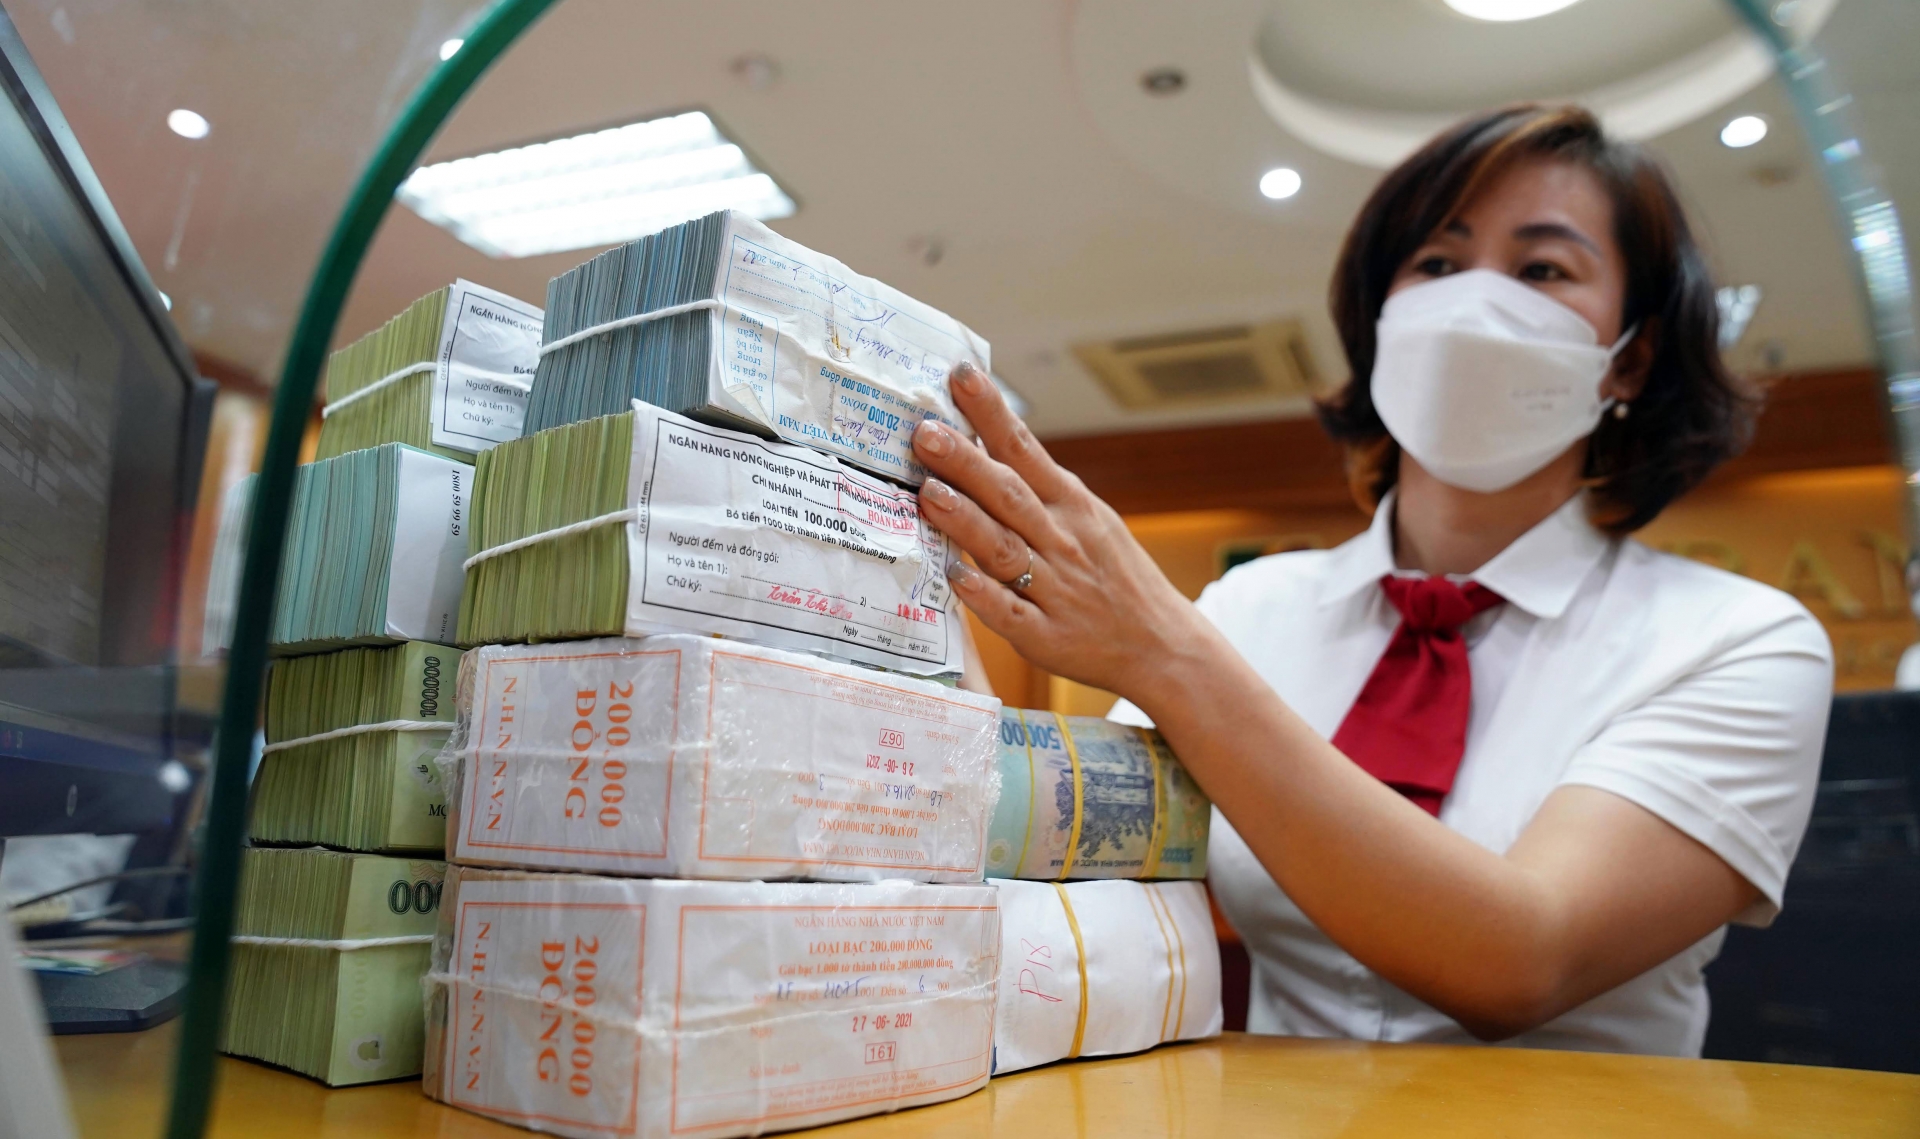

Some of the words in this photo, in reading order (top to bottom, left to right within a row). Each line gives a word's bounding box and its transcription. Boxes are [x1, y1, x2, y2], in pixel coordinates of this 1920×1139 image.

[470, 305, 494, 321] NGÂN
[494, 314, 519, 328] HÀNG
[740, 313, 764, 329] hàng
[737, 327, 762, 342] Ngân
[750, 343, 763, 353] nội
[737, 350, 761, 366] trong
[743, 367, 756, 377] giá
[820, 367, 840, 383] đồng
[466, 379, 492, 392] Người
[492, 385, 512, 398] đếm
[514, 389, 524, 398] và
[841, 377, 882, 400] 20.000.000
[464, 397, 477, 408] Họ
[478, 398, 488, 408] và
[489, 400, 503, 411] tên
[840, 395, 869, 412] ĐỒNG
[463, 412, 480, 423] Chữ
[778, 414, 801, 432] NAM
[868, 405, 900, 431] 20.000
[802, 422, 828, 440] VIỆT
[858, 442, 866, 452] &
[867, 443, 902, 467] NGHIỆP
[669, 434, 699, 450] NGÂN
[701, 442, 731, 459] HÀNG
[733, 450, 763, 466] NÔNG
[763, 460, 796, 478] NGHIỆP
[797, 470, 808, 482] VÀ
[809, 471, 831, 490] PHÁT
[452, 469, 461, 493] 1800
[642, 481, 649, 496] mm
[752, 474, 767, 488] CHI
[768, 480, 802, 499] NHÁNH
[452, 494, 462, 507] 59
[452, 507, 461, 521] 99
[762, 499, 779, 514] LOẠI
[780, 503, 799, 519] TIỀN
[804, 510, 848, 533] 100.000
[451, 523, 461, 537] 59
[726, 509, 739, 519] Bó
[763, 516, 783, 529] 1000
[797, 526, 820, 540] thành
[838, 538, 879, 557] 100.000.000
[669, 531, 700, 546] Người
[702, 538, 724, 552] đếm
[726, 543, 737, 554] và
[739, 546, 762, 561] đóng
[764, 552, 780, 564] gói:
[667, 553, 681, 567] Họ
[684, 558, 695, 568] và
[698, 560, 714, 572] tên
[717, 563, 728, 575] 1):
[666, 575, 688, 588] Chữ
[688, 580, 702, 593] ký:
[859, 597, 867, 608] 2)
[843, 624, 859, 637] Ngày
[876, 634, 892, 647] tháng
[420, 656, 441, 718] 100.000
[881, 731, 903, 747] 067
[486, 676, 518, 830] N.H.N.N.V.N
[565, 686, 601, 820] ĐỒNG
[598, 680, 634, 828] 200.000
[871, 805, 891, 816] thành
[877, 822, 896, 837] BẠC
[898, 823, 918, 838] LOẠI
[794, 914, 824, 928] NGÂN
[827, 914, 857, 928] HÀNG
[859, 914, 879, 927] NHÀ
[882, 914, 907, 928] NƯỚC
[909, 915, 925, 929] VIỆT
[926, 915, 945, 927] NAM
[809, 941, 840, 957] LOẠI
[843, 941, 868, 957] BẠC
[870, 939, 905, 954] 200.000
[907, 938, 933, 951] ĐỒNG
[816, 962, 839, 975] 1.000
[852, 961, 877, 973] thành
[879, 957, 896, 971] tiền
[897, 958, 935, 971] 200.000.000
[936, 955, 954, 970] đồng
[880, 984, 897, 998] Đến
[918, 975, 925, 993] 6
[937, 981, 950, 991] 000
[466, 922, 491, 1092] N.H.N.N.V.N
[537, 938, 569, 1083] ĐỒNG
[567, 934, 600, 1097] 200.000
[895, 1012, 913, 1028] 2021
[870, 1046, 893, 1060] 161
